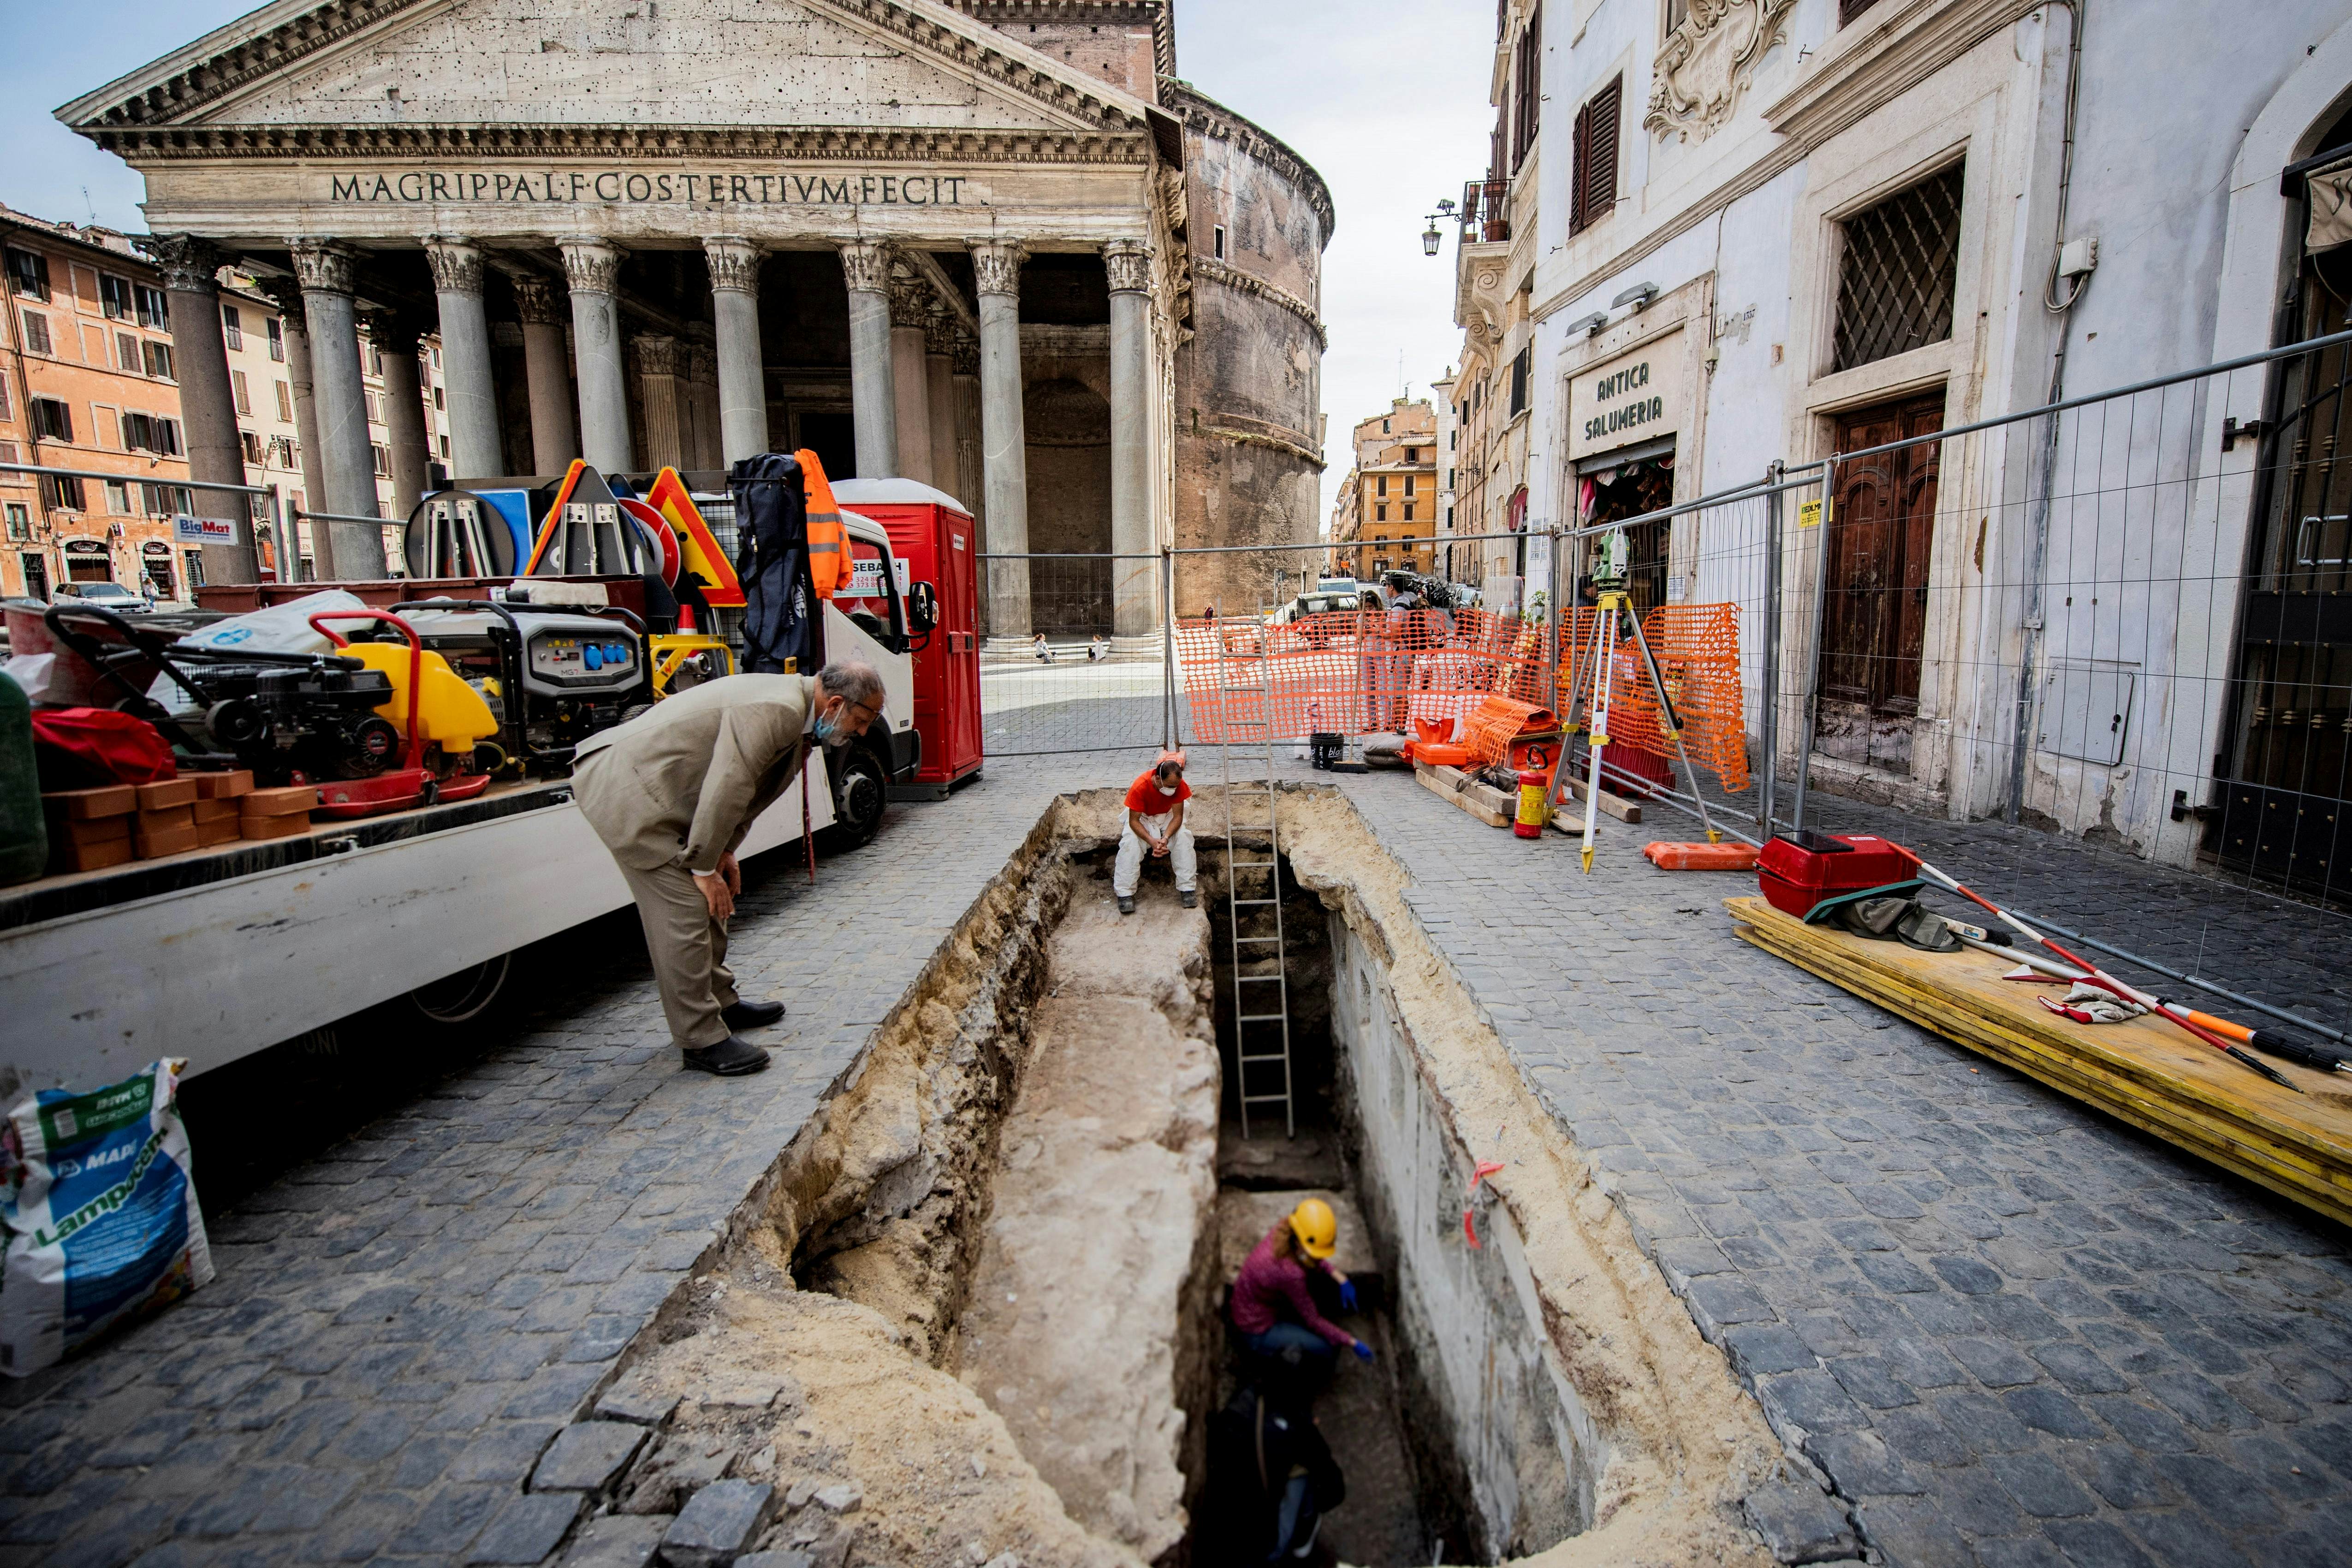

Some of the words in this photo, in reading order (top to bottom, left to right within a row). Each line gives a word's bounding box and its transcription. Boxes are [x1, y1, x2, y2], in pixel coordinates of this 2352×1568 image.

[371, 173, 536, 202] AGRIPPA
[595, 173, 672, 202] COS
[678, 174, 849, 204] TERTIVM
[861, 176, 966, 205] FECIT
[1598, 362, 1649, 402] ANTICA
[1586, 396, 1662, 440] SALUMERIA
[179, 519, 230, 534] BigMat
[853, 562, 902, 572] SEBAH
